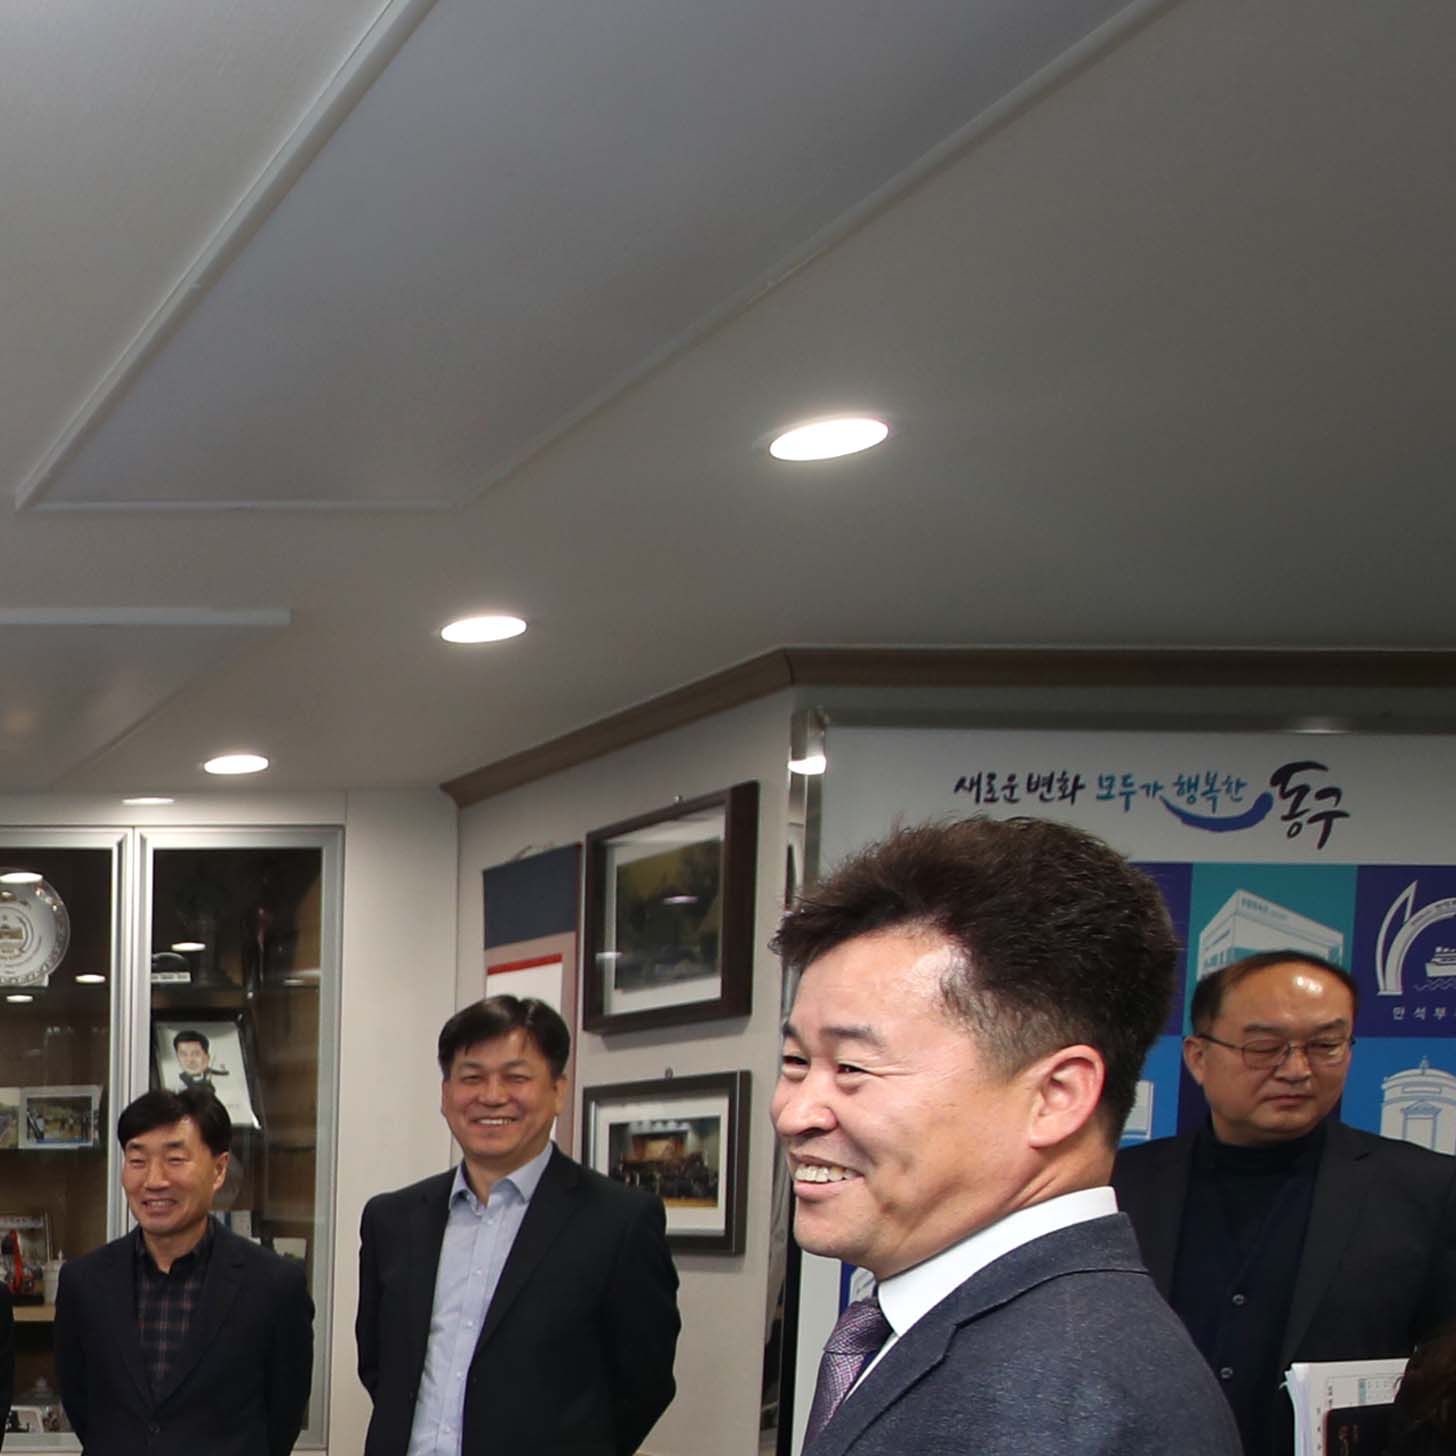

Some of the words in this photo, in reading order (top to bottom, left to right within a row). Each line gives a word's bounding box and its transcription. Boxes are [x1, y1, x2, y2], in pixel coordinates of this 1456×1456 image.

[954, 771, 1020, 805] 새로운
[1026, 770, 1086, 806] 변화
[1096, 773, 1163, 812] 모두가
[1171, 770, 1247, 814] 행복한
[1269, 761, 1351, 850] 동구
[1392, 1006, 1456, 1020] 만석부
